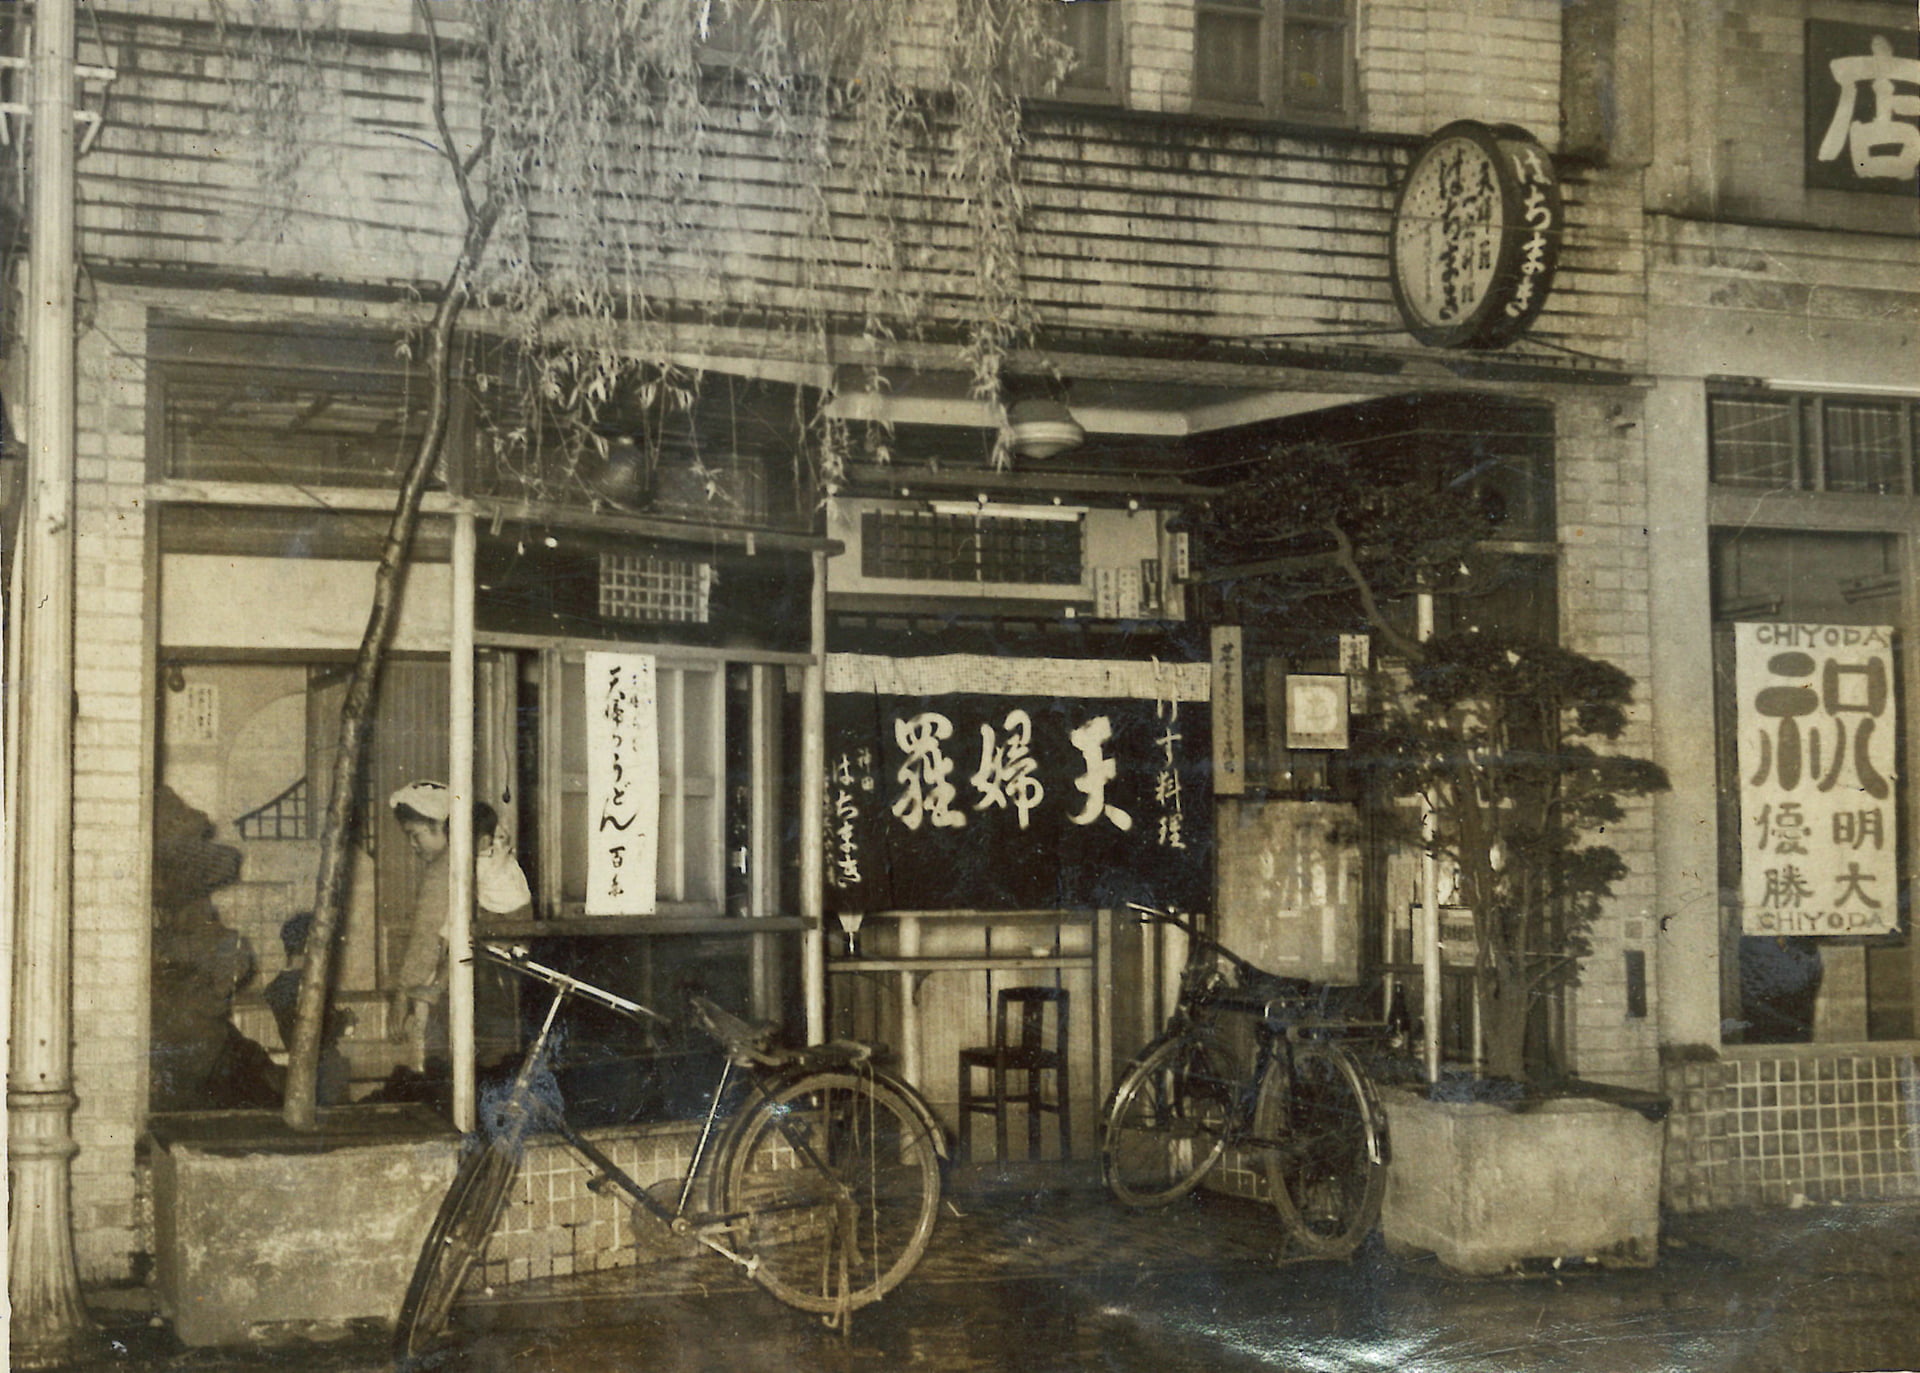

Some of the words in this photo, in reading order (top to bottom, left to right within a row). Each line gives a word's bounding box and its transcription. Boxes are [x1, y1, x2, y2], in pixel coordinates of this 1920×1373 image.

[1817, 33, 1919, 181] 店
[1505, 149, 1553, 318] はちまき
[1756, 625, 1890, 648] CHIYODA
[1750, 651, 1889, 800] 祝
[832, 752, 862, 888] はちまき
[1757, 802, 1816, 910] 優勝
[1832, 806, 1884, 910] 明大
